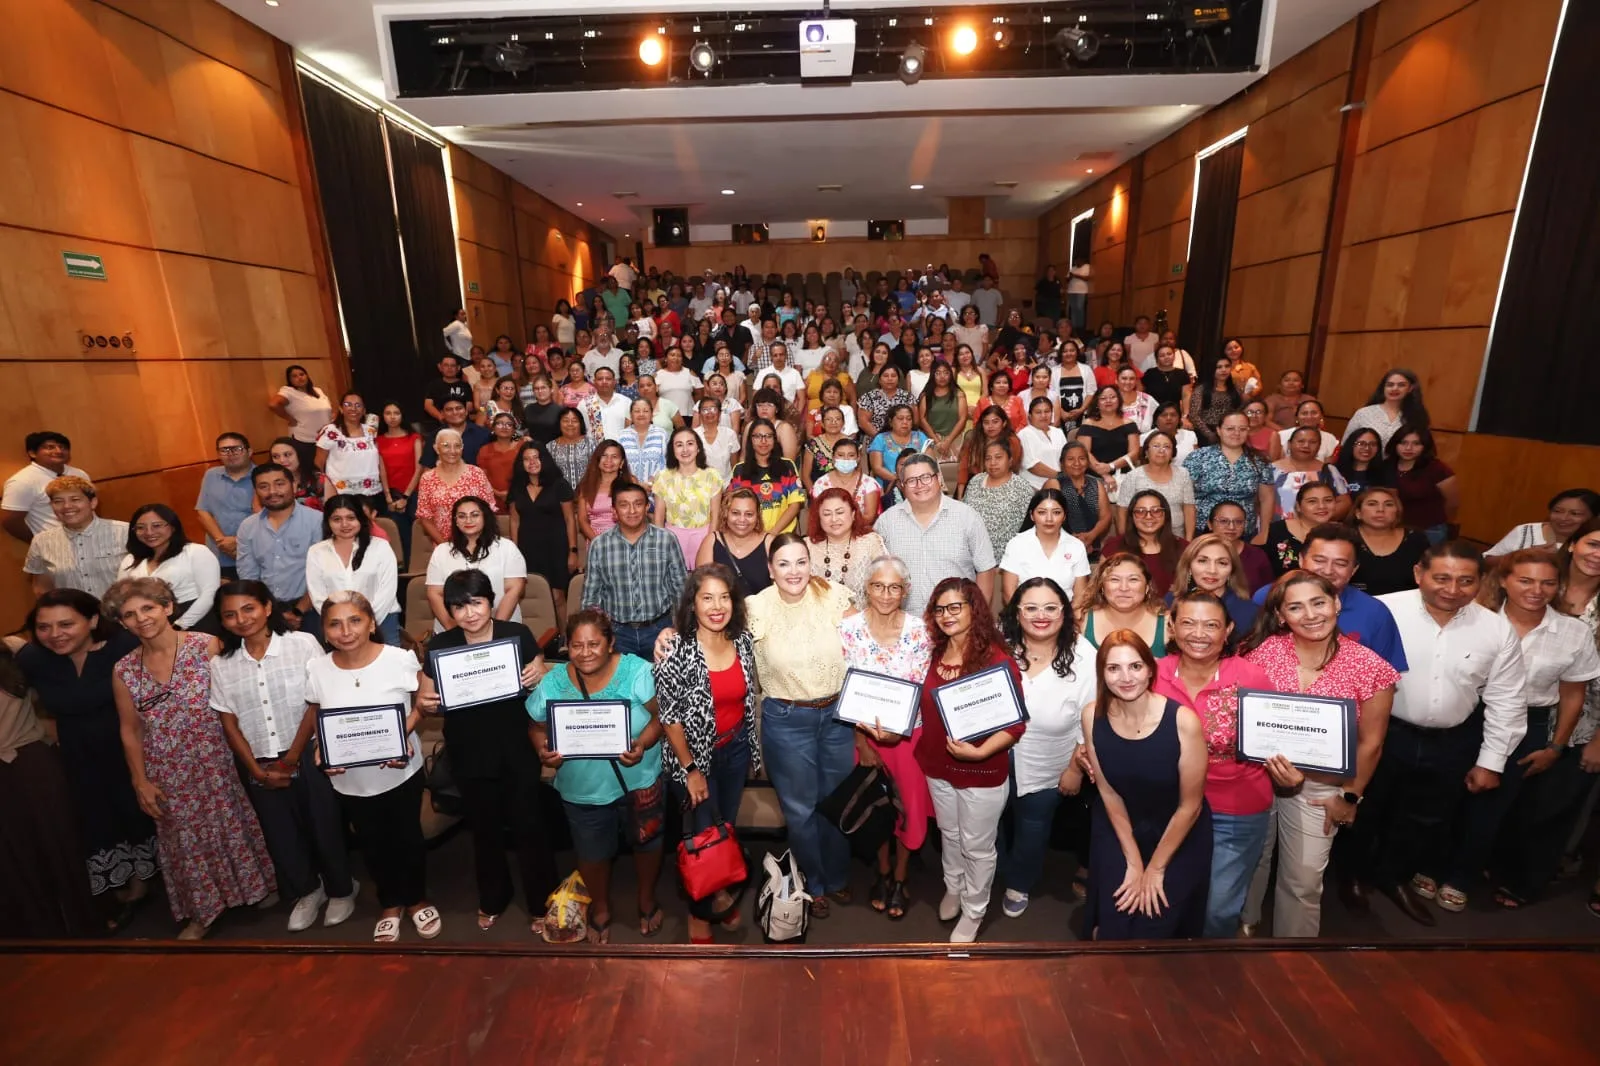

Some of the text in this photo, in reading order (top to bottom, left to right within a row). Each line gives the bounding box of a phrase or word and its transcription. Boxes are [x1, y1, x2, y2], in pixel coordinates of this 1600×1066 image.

[452, 664, 506, 680] RECONOCIMIENTO
[953, 692, 1002, 712] RECONOCIMIENTO
[336, 728, 389, 739] RECONOCIMIENTO
[1256, 721, 1328, 734] RECONOCIMIENTO
